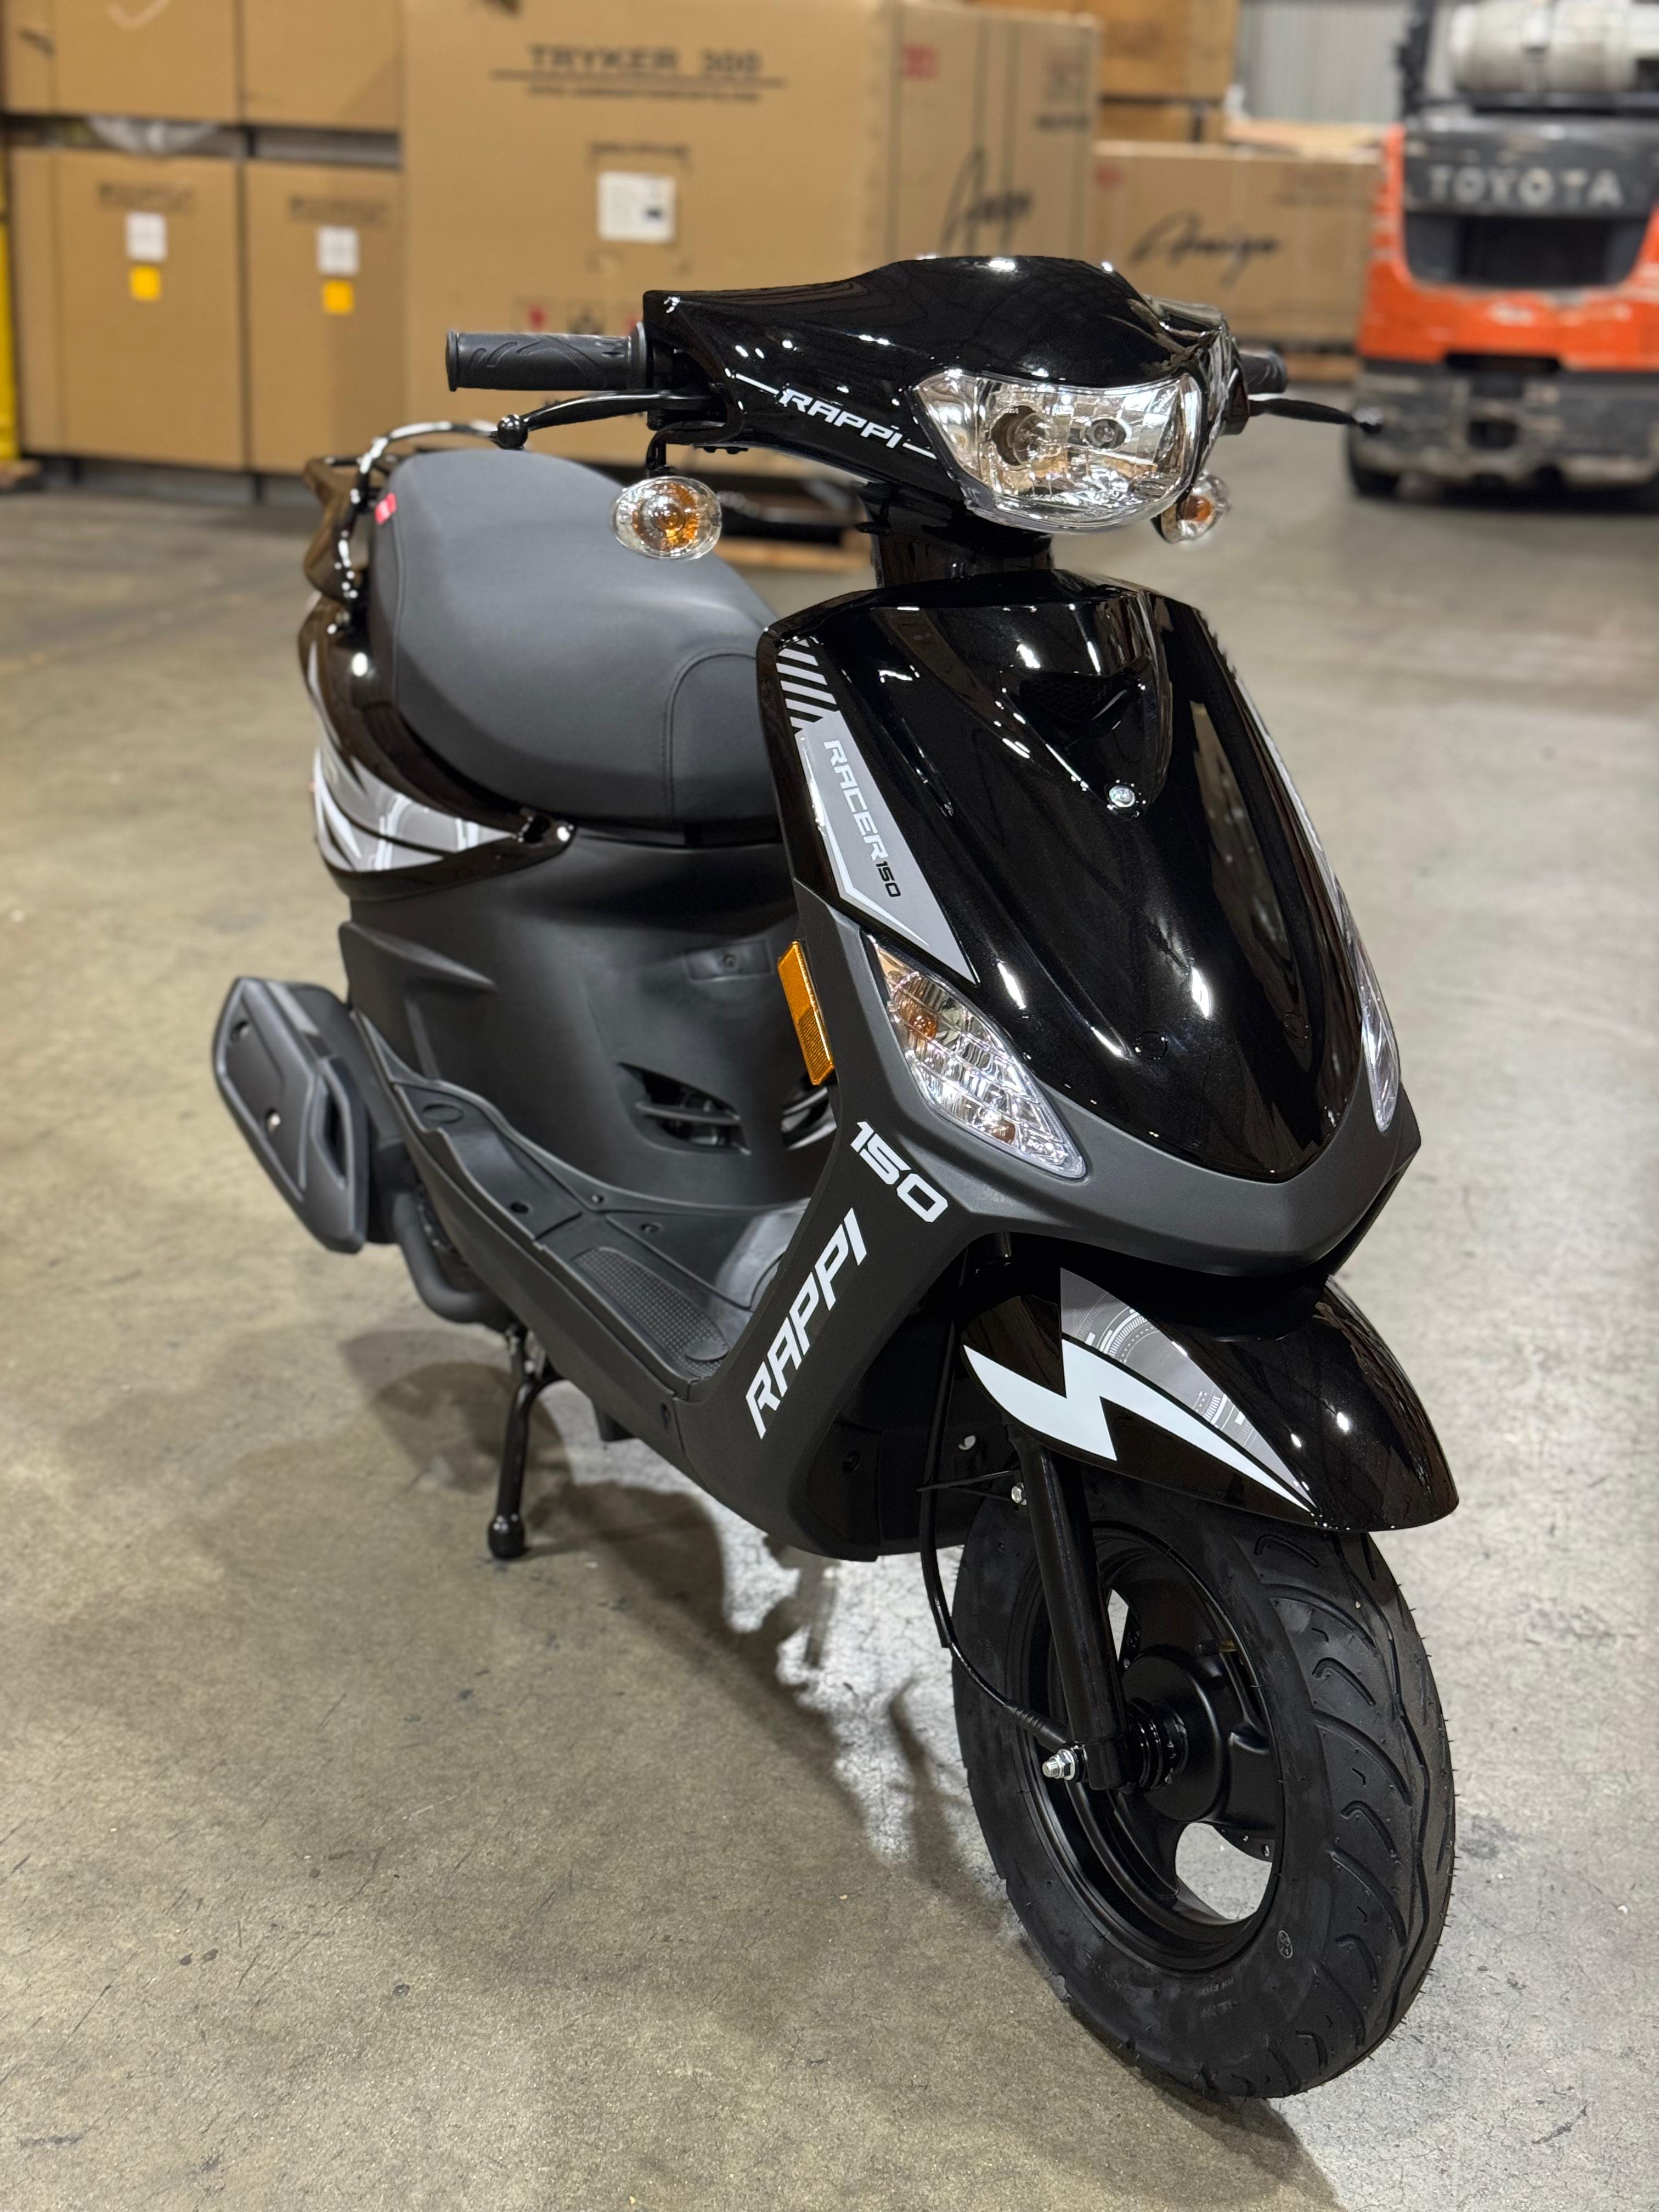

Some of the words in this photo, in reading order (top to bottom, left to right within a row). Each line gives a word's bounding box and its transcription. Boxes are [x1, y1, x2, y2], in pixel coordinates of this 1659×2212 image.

[528, 43, 680, 72] TRYKER
[1429, 165, 1624, 207] TOYOTA
[778, 388, 903, 449] RAPPI
[823, 740, 889, 861] RACER
[876, 860, 901, 898] 150
[850, 1121, 949, 1222] 150
[746, 1207, 867, 1440] RAPPI
